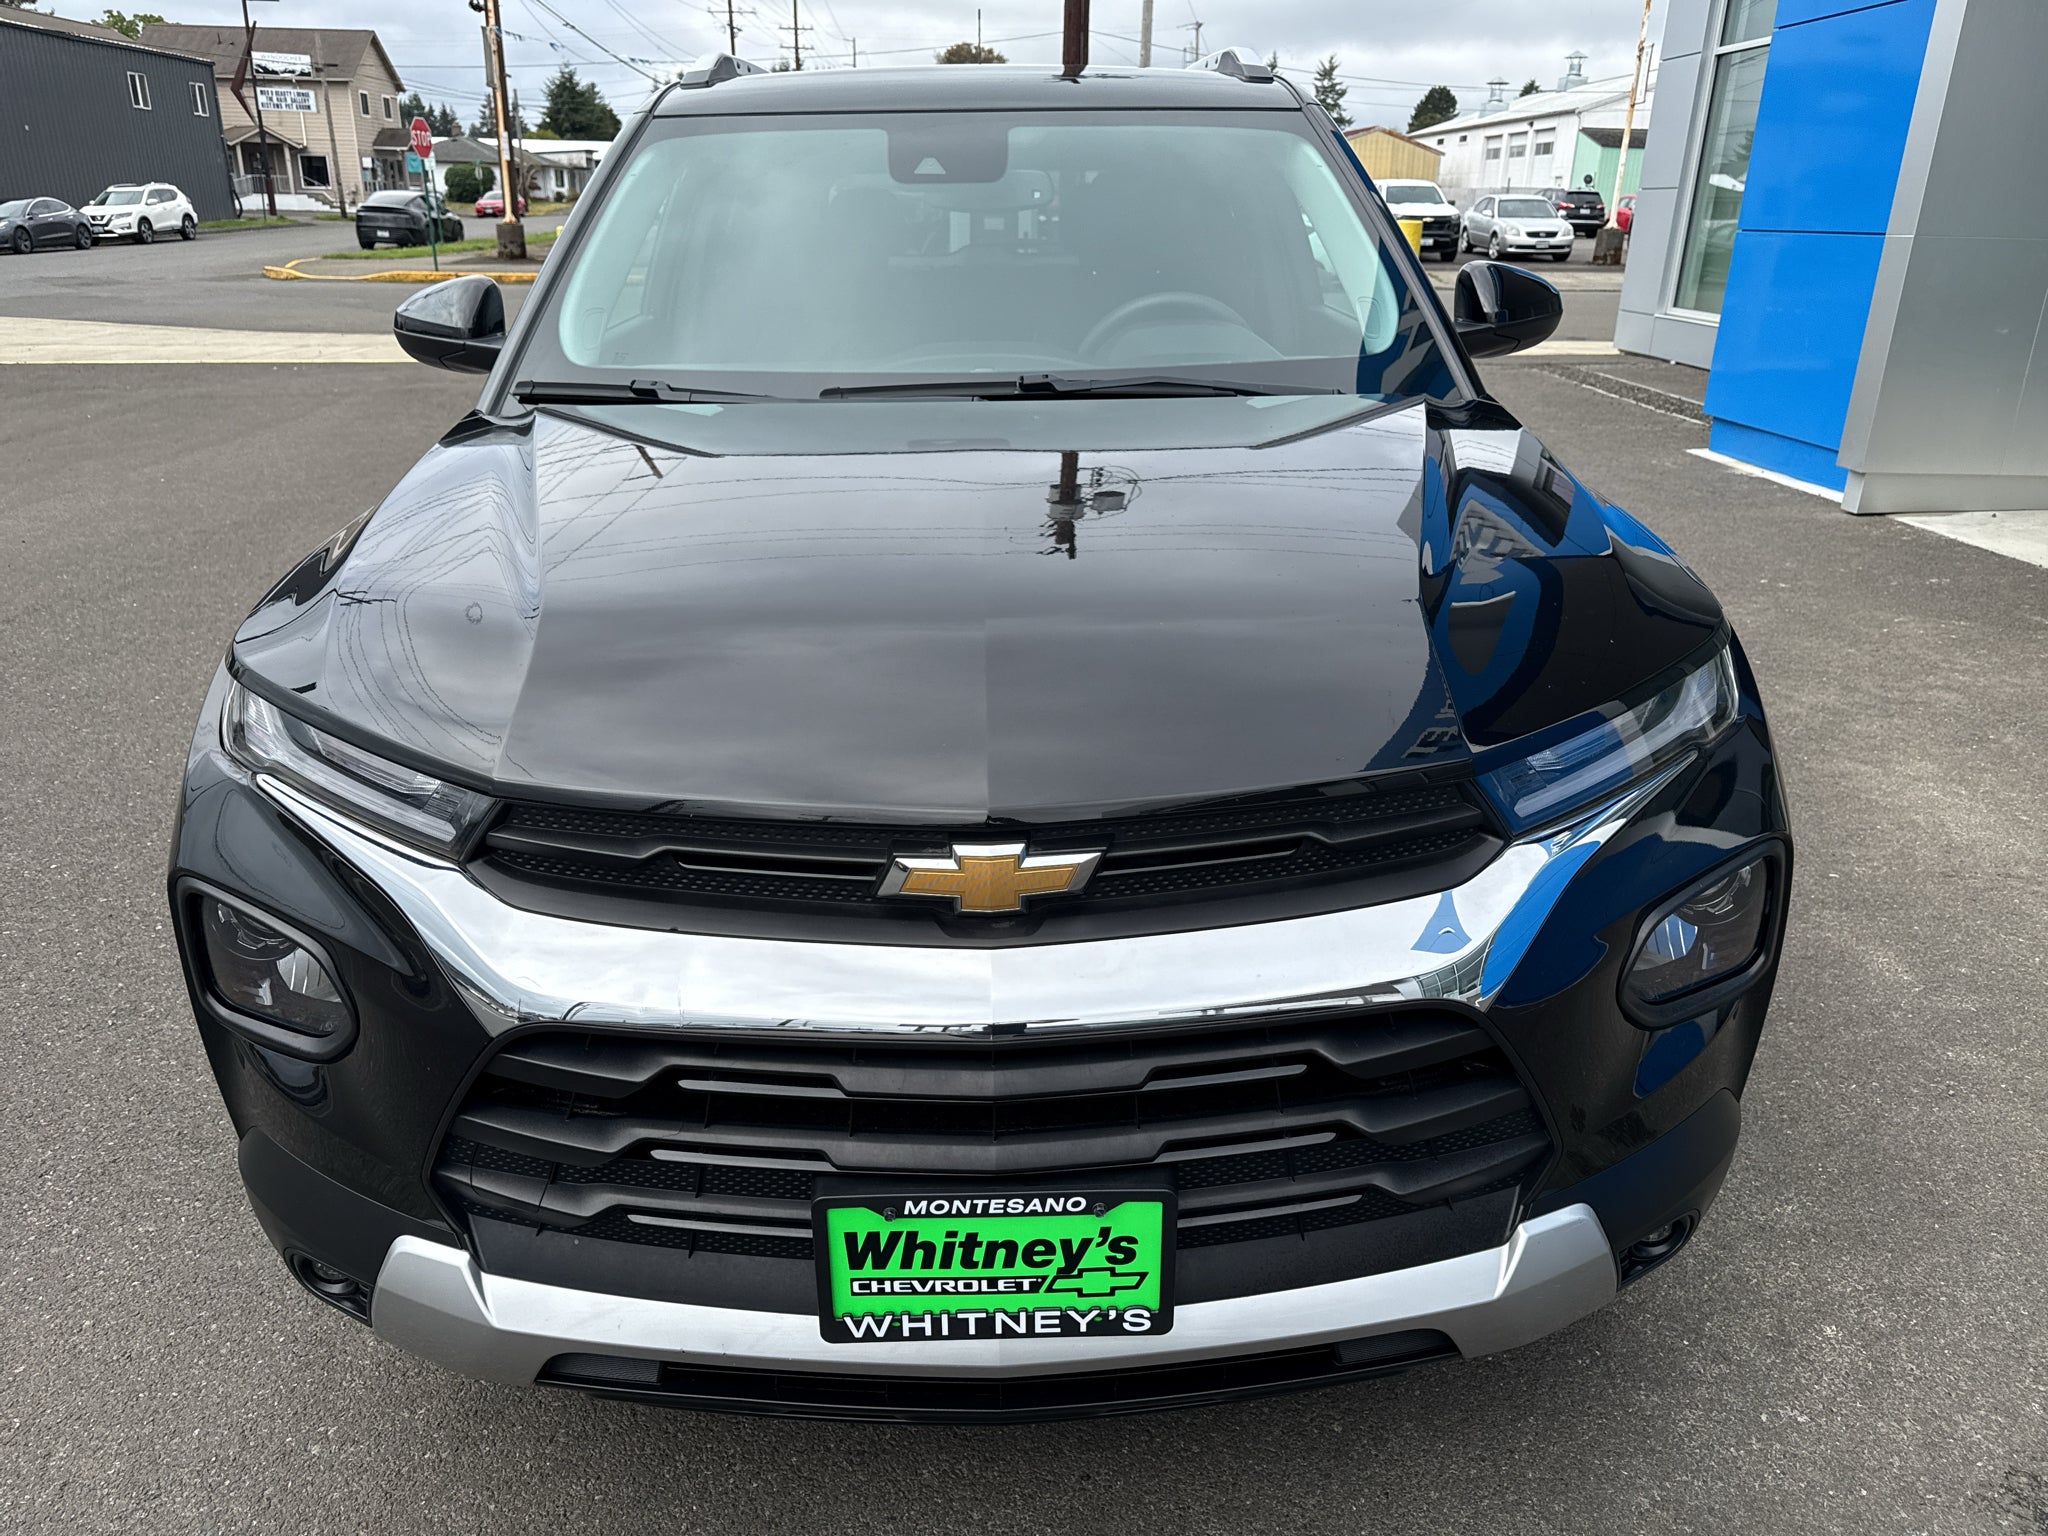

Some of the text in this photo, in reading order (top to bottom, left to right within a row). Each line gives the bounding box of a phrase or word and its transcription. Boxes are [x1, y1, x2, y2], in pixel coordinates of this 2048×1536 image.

[412, 130, 432, 147] STOP
[904, 1196, 1087, 1215] MONTESANO
[843, 1226, 1139, 1274] Whitney's
[852, 1278, 1038, 1293] CHEVROLET
[843, 1308, 1152, 1339] WHITNEY'S
